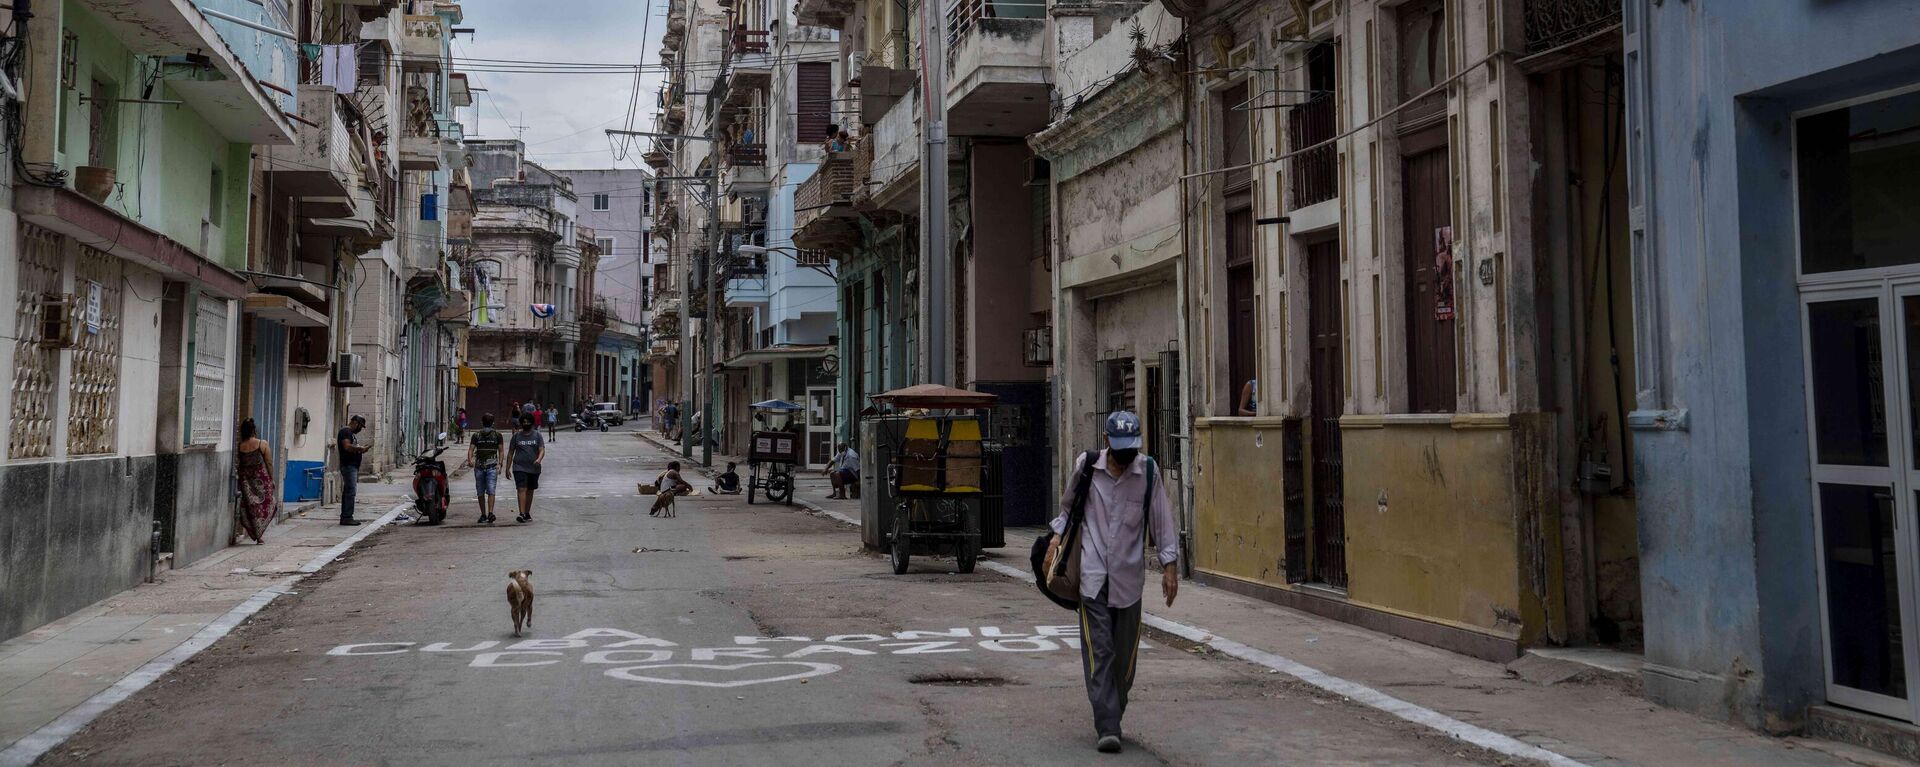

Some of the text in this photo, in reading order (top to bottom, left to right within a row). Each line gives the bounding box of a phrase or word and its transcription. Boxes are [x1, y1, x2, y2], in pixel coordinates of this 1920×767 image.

[1116, 421, 1133, 433] NY
[562, 628, 648, 639] A
[326, 626, 1081, 656] CUBA PONLE
